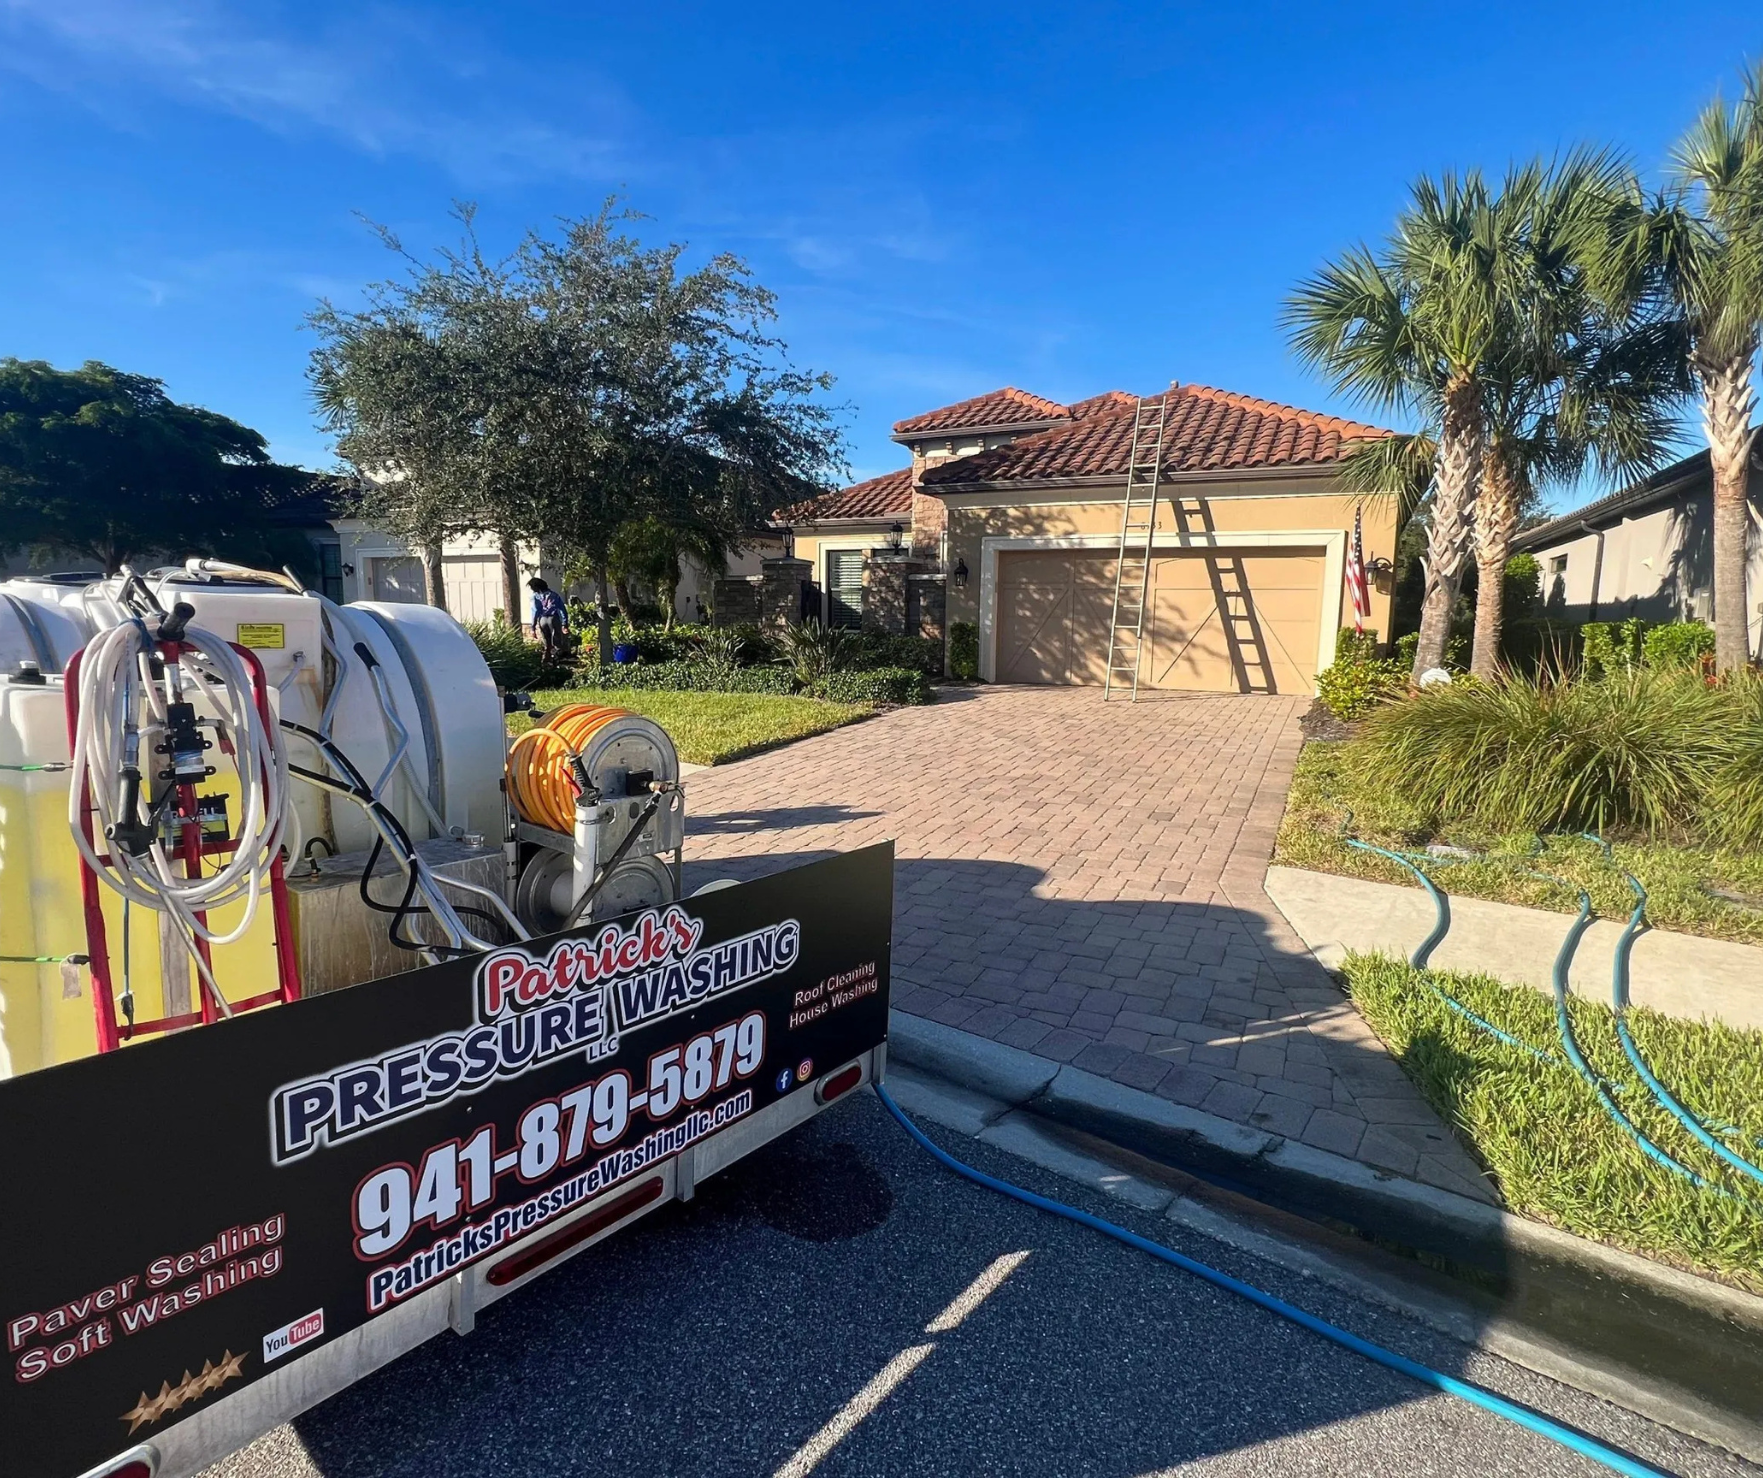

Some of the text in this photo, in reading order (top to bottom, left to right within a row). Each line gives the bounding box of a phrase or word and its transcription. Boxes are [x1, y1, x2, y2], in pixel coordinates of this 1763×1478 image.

[481, 907, 702, 1018] Patrick's
[788, 977, 879, 1029] House Washing
[794, 960, 876, 1007] Roof Cleaning
[278, 922, 801, 1158] PRESSURE WASHING
[588, 1035, 619, 1062] LLC
[355, 1012, 766, 1258] 941-879-5879
[369, 1088, 753, 1310] PatricksPressureWashingllc.com
[9, 1212, 285, 1350] Paver Sealing
[17, 1246, 283, 1382] Soft Washing
